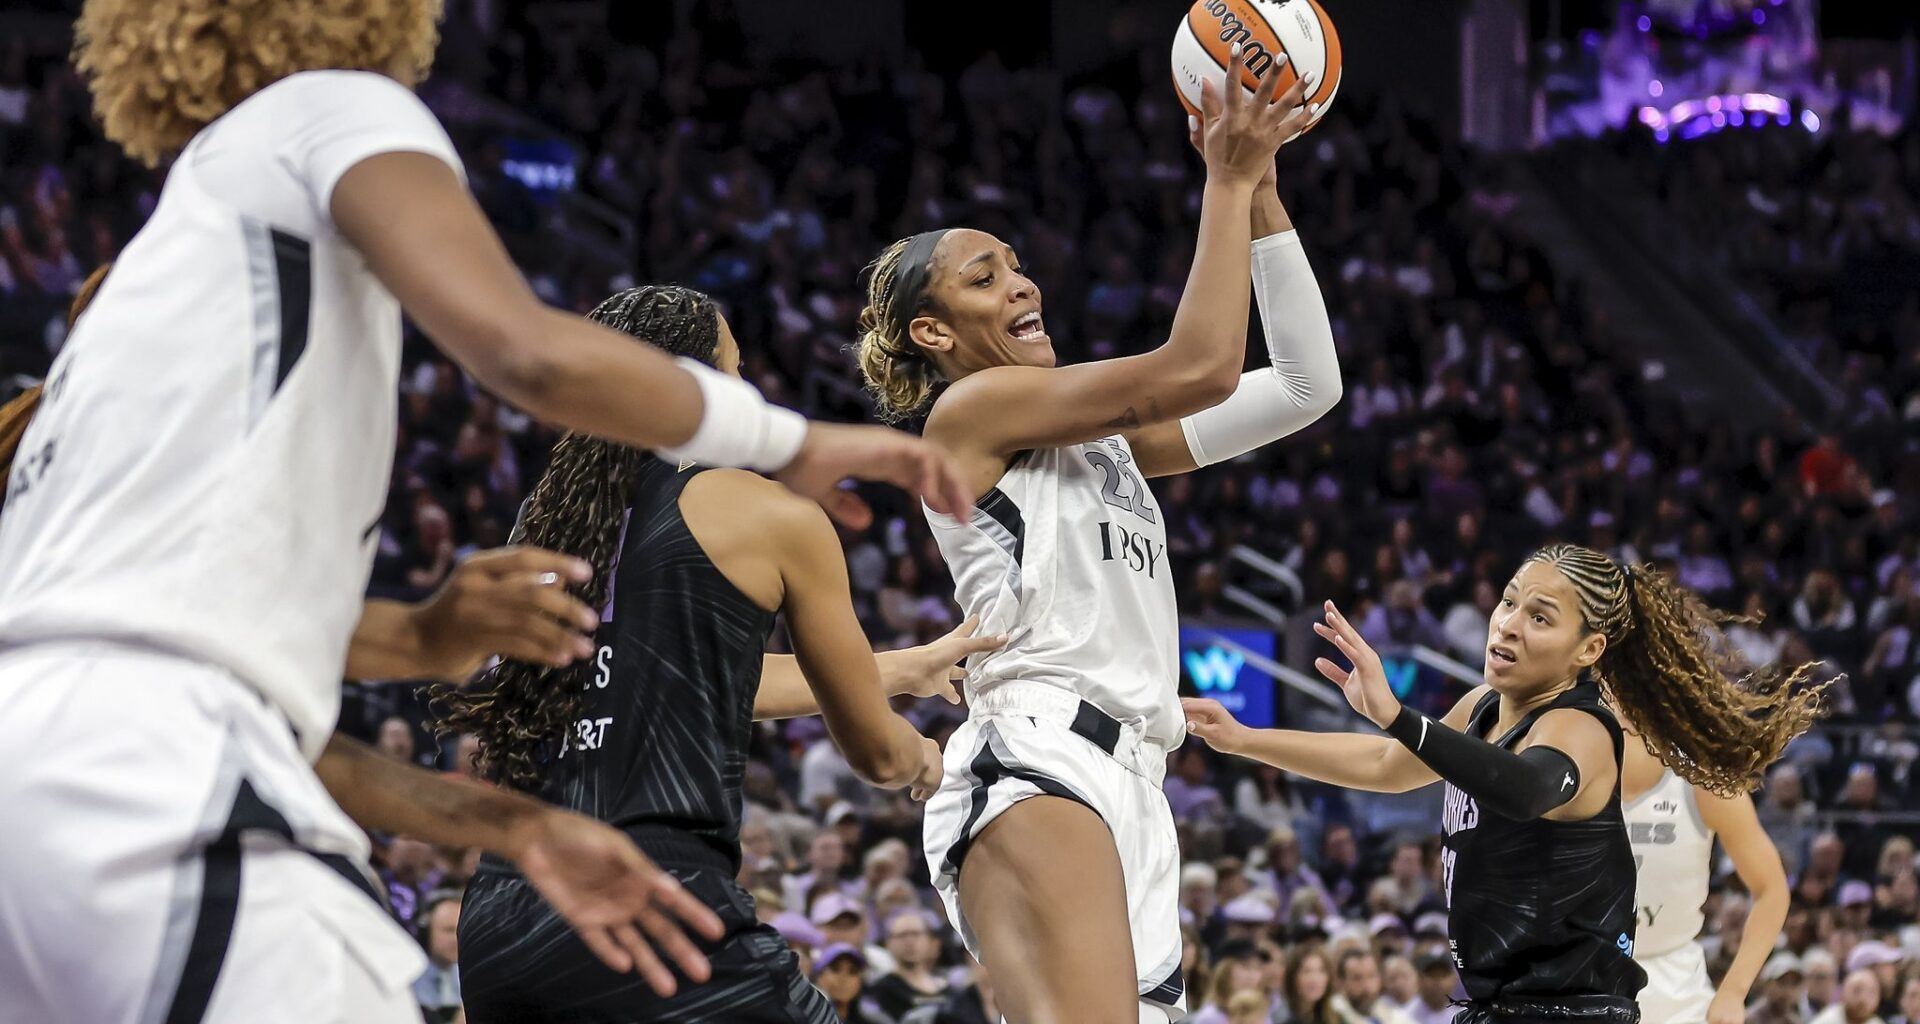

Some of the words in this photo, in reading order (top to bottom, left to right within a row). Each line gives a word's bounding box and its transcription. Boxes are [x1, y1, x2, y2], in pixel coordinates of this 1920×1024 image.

[1204, 0, 1274, 80] Wilson
[1085, 451, 1156, 525] 22
[1098, 521, 1164, 580] IPSY
[1627, 822, 1677, 845] ES
[1653, 800, 1678, 815] ally
